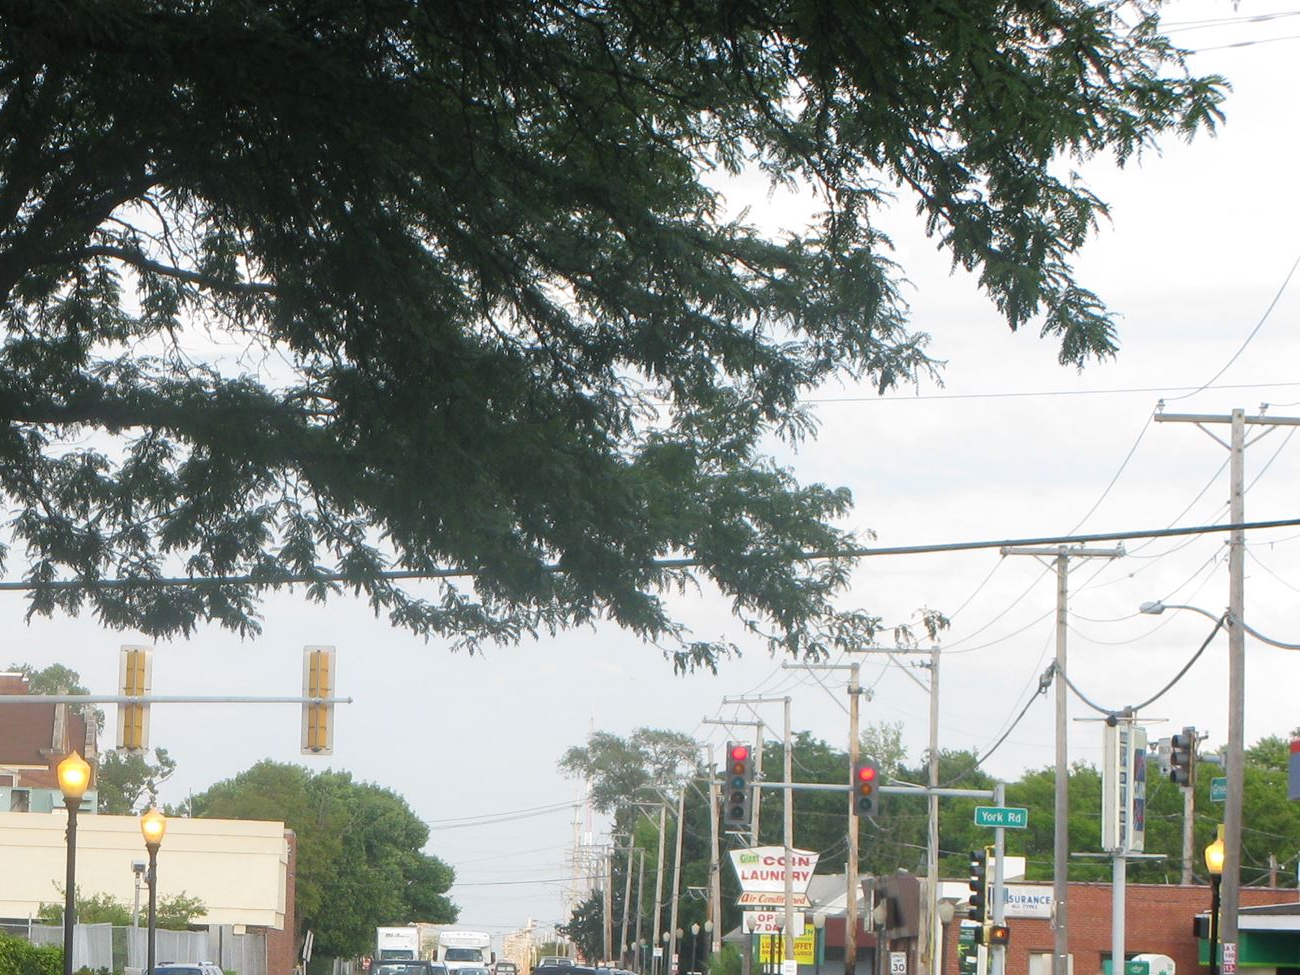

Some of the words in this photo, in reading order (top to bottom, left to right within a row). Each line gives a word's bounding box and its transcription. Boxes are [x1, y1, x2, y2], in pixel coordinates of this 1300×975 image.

[982, 811, 1003, 822] York
[1008, 813, 1021, 823] Rd
[1008, 895, 1051, 904] SURANCE
[892, 963, 905, 972] 30
